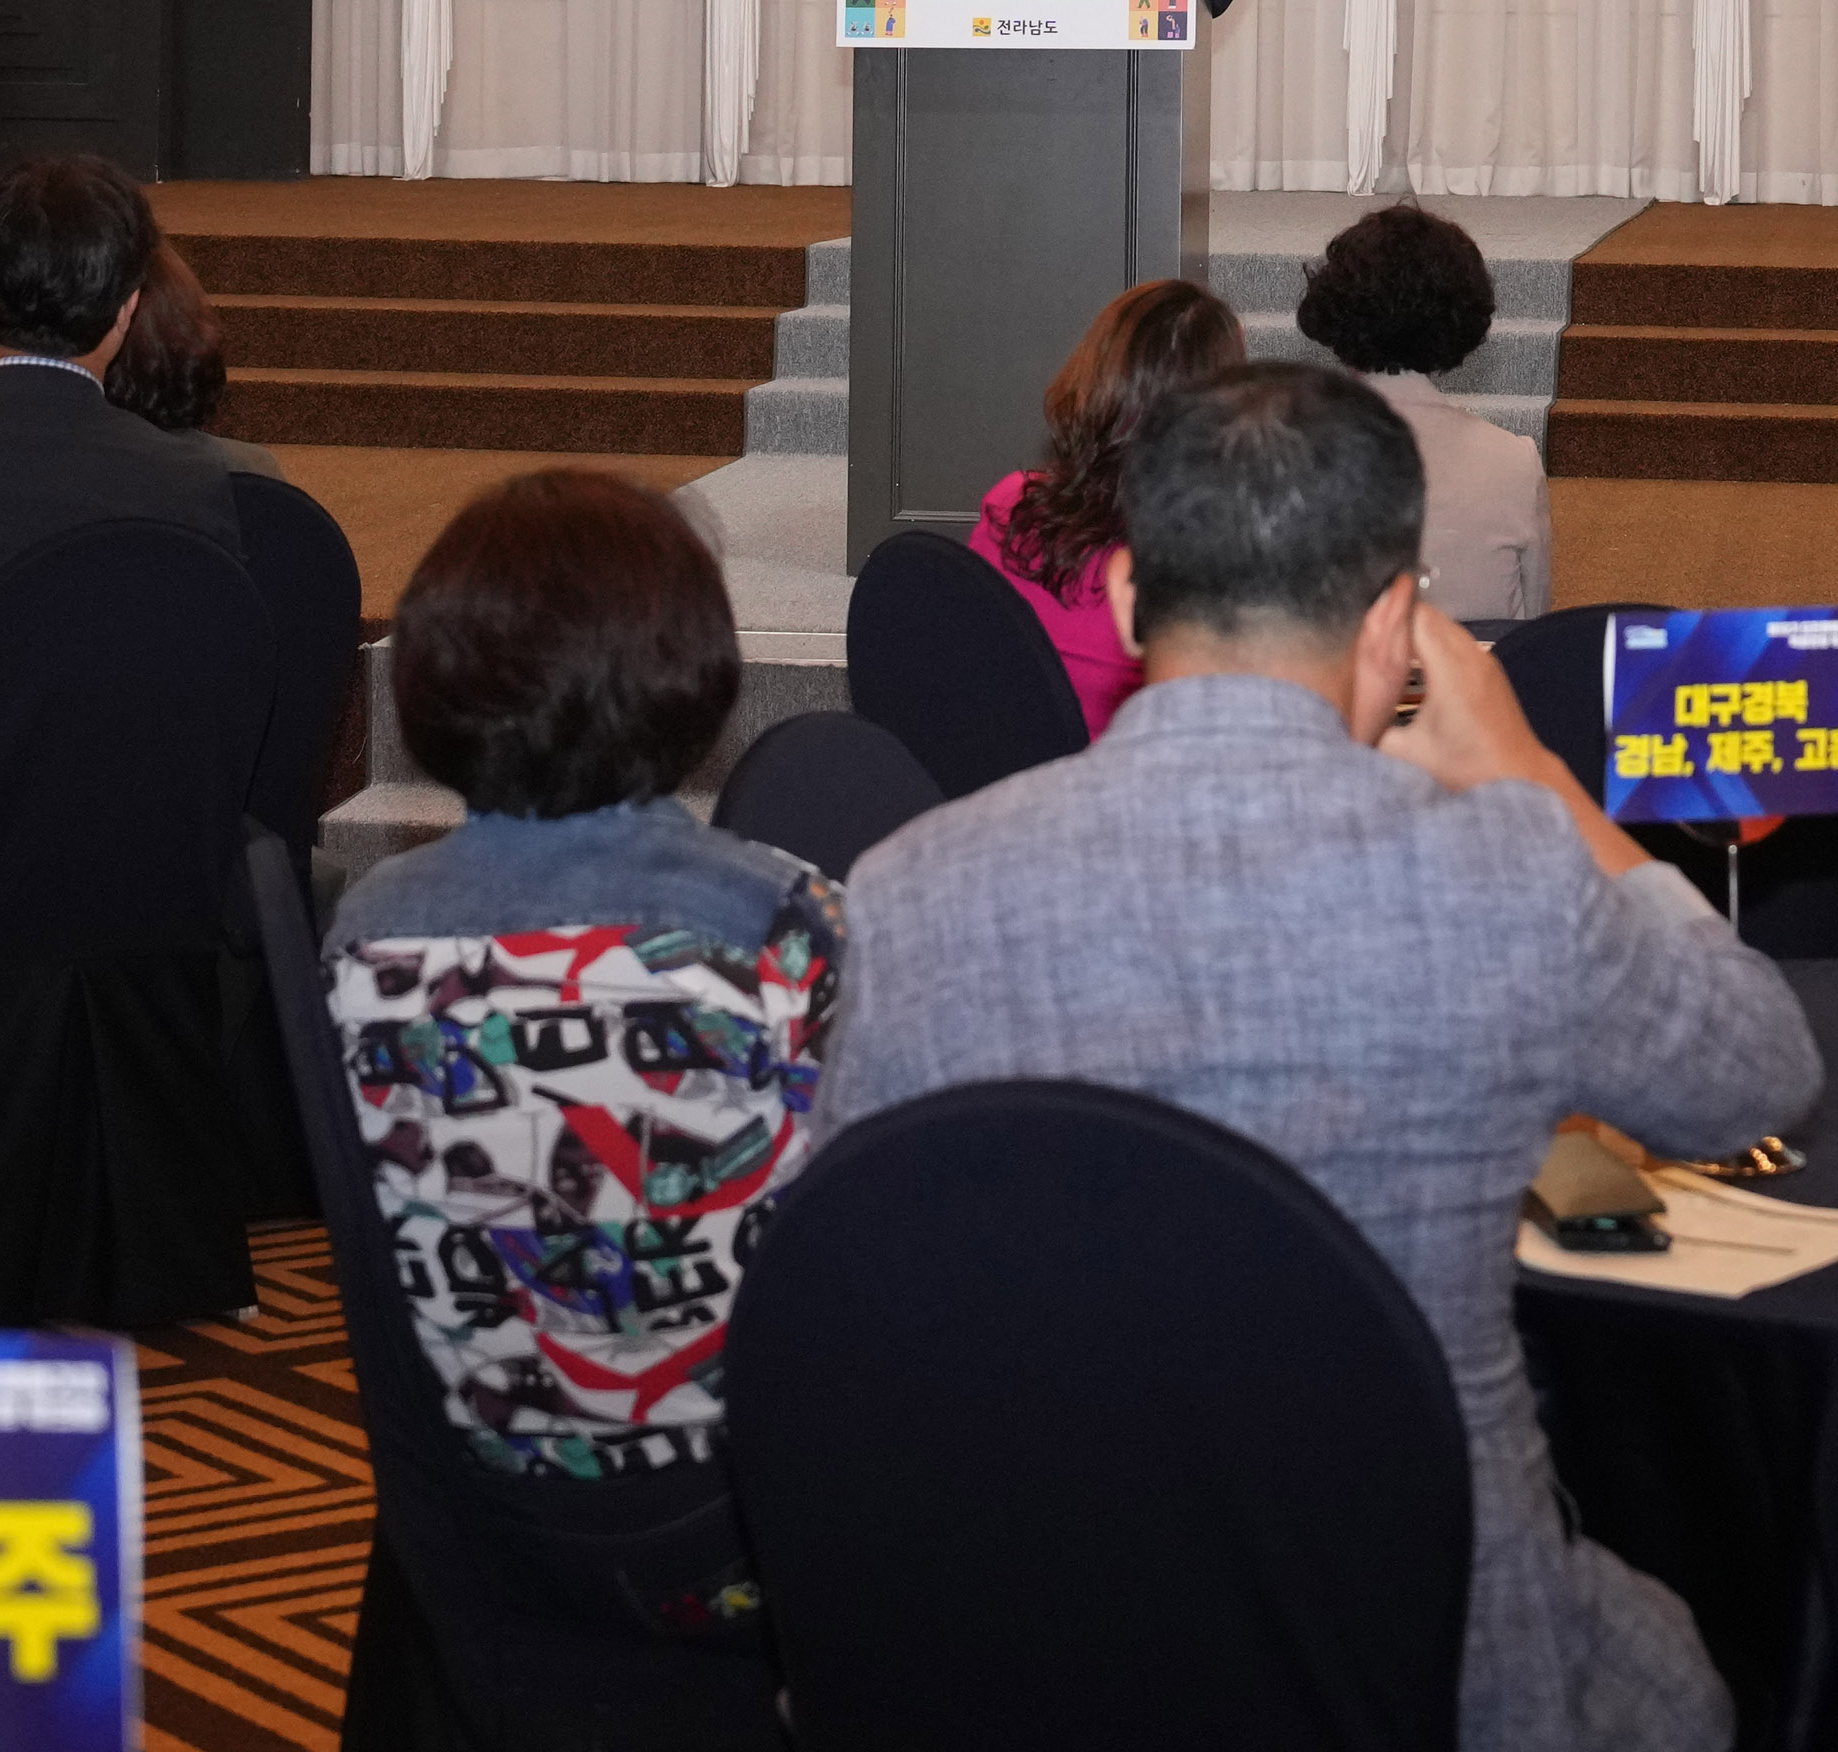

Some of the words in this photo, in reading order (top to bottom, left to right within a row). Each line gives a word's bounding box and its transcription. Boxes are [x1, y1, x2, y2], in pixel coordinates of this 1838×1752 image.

[998, 20, 1057, 35] 전라남도
[1675, 680, 1808, 726] 대구경북
[1615, 733, 1695, 777] 경남,
[1707, 730, 1783, 773] 제주,
